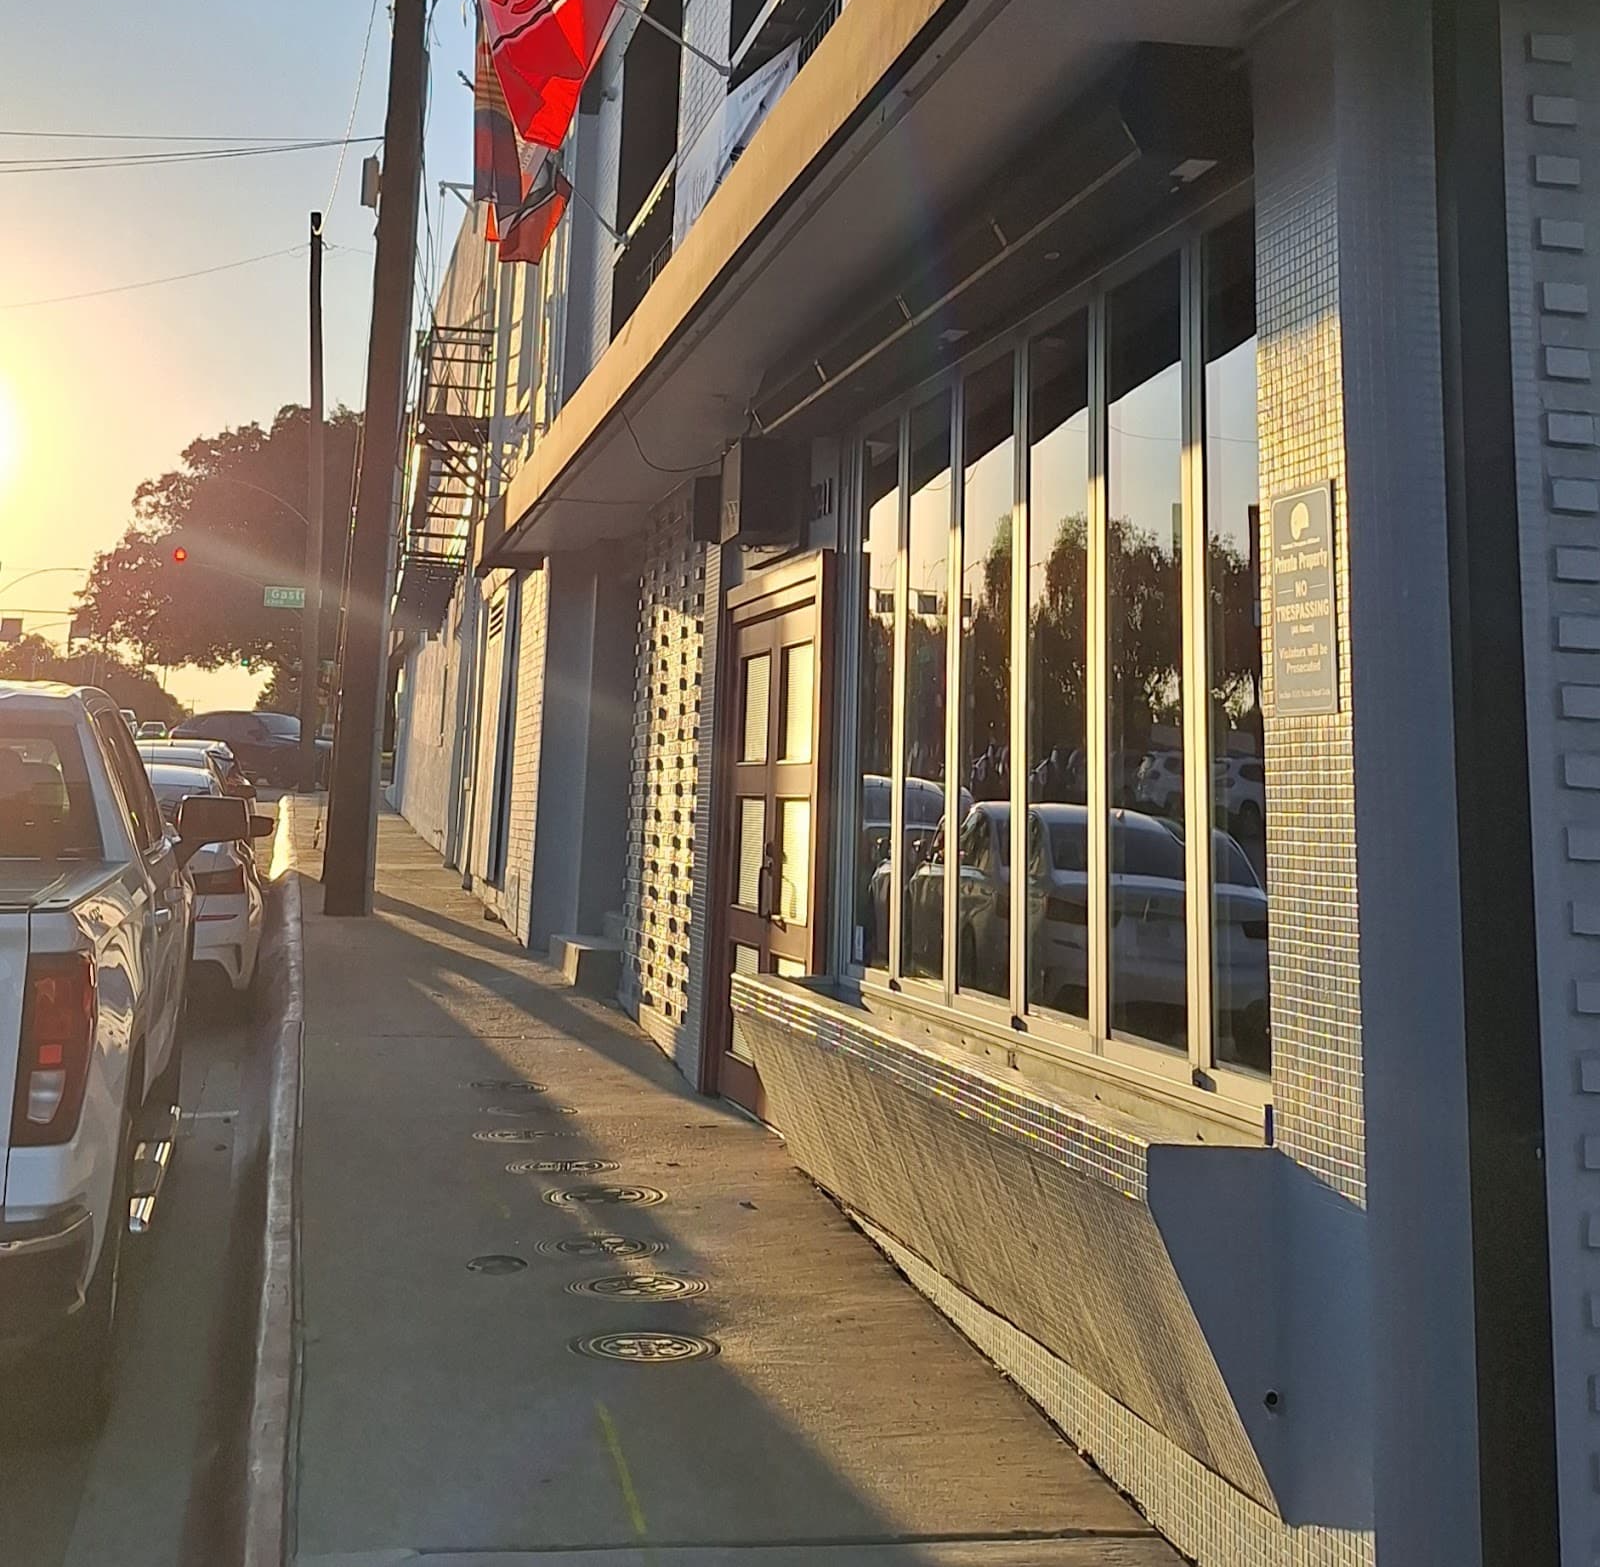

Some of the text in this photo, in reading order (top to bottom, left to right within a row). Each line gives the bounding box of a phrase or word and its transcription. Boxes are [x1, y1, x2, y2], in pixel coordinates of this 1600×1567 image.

[1275, 547, 1328, 574] Private Property
[1295, 579, 1307, 597] NO
[1276, 598, 1329, 623] TRESPASSING
[1307, 643, 1319, 656] will
[1319, 643, 1328, 655] be
[1286, 659, 1321, 674] Prosecuted
